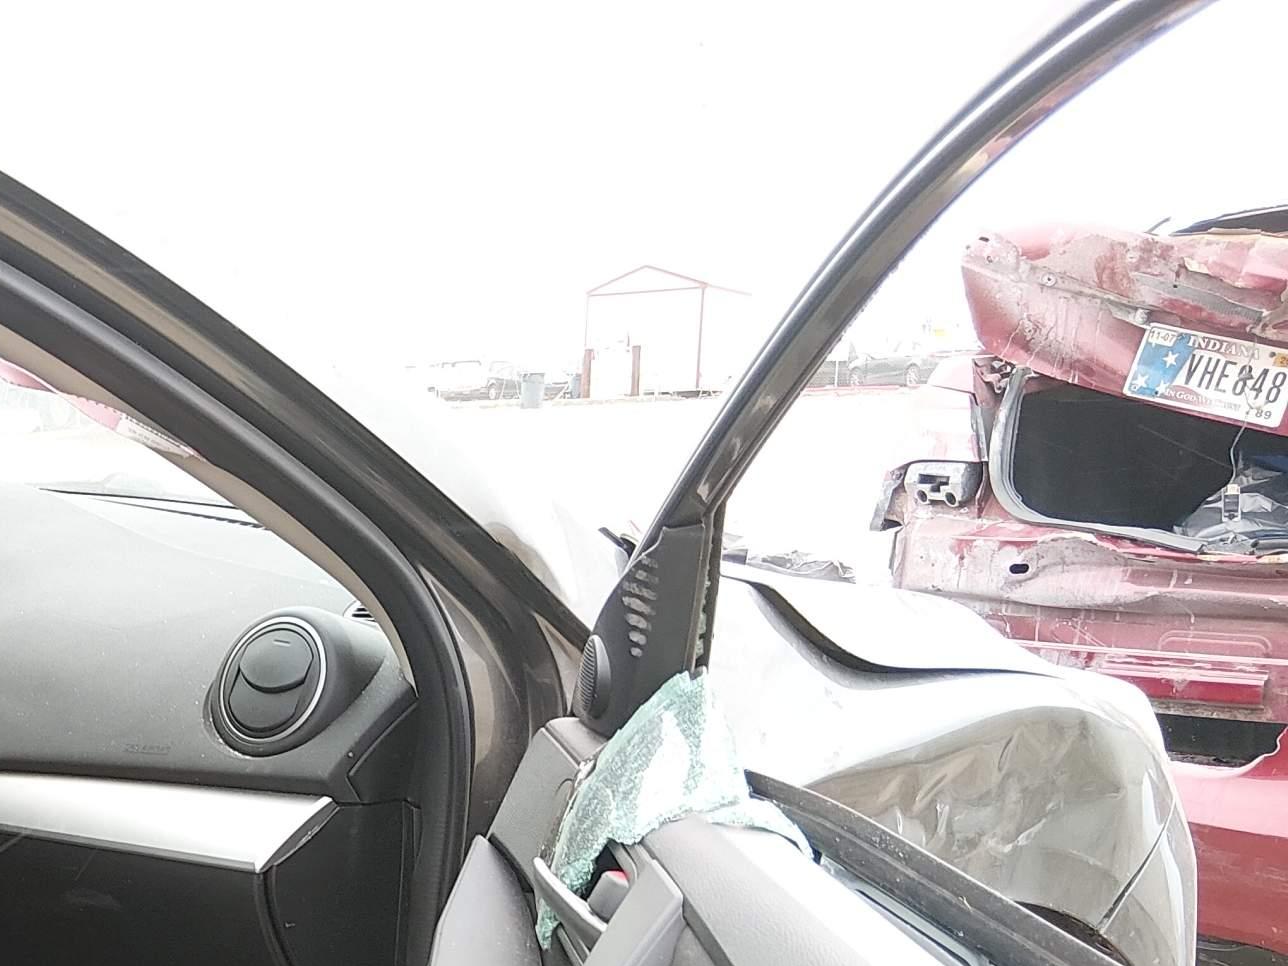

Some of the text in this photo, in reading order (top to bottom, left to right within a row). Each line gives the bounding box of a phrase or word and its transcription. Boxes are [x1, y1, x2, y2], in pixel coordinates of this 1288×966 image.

[1187, 335, 1260, 361] INDIANA
[1184, 352, 1288, 404] VHE848
[1255, 408, 1272, 420] 89
